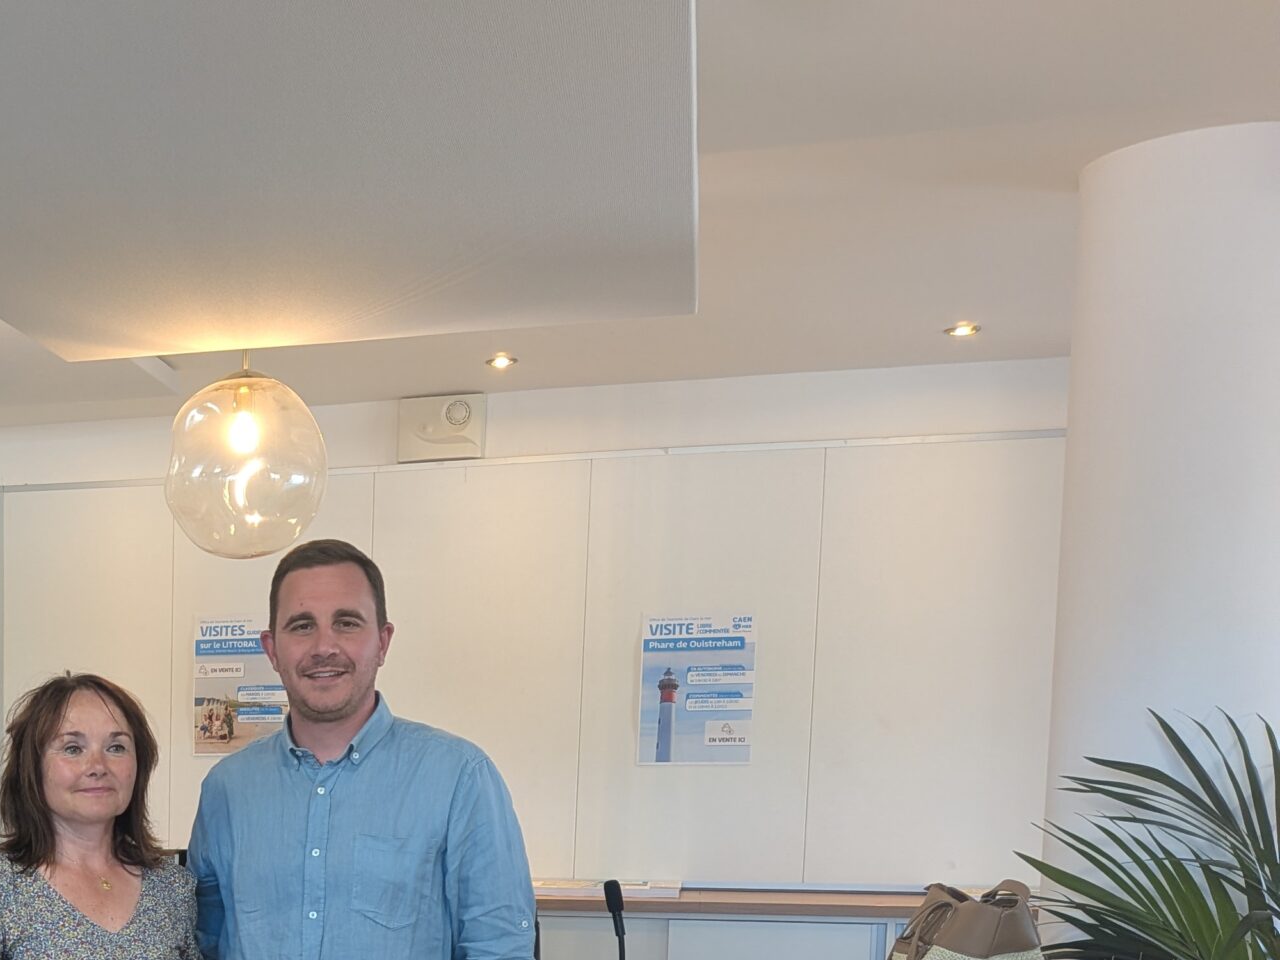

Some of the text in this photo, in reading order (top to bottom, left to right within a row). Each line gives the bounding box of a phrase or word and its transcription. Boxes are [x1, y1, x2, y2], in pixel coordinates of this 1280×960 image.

[200, 624, 246, 637] VISITES
[649, 623, 694, 636] VISITE
[222, 640, 257, 648] LITTORAL
[649, 641, 675, 649] Phare
[689, 640, 741, 648] Ouistreham
